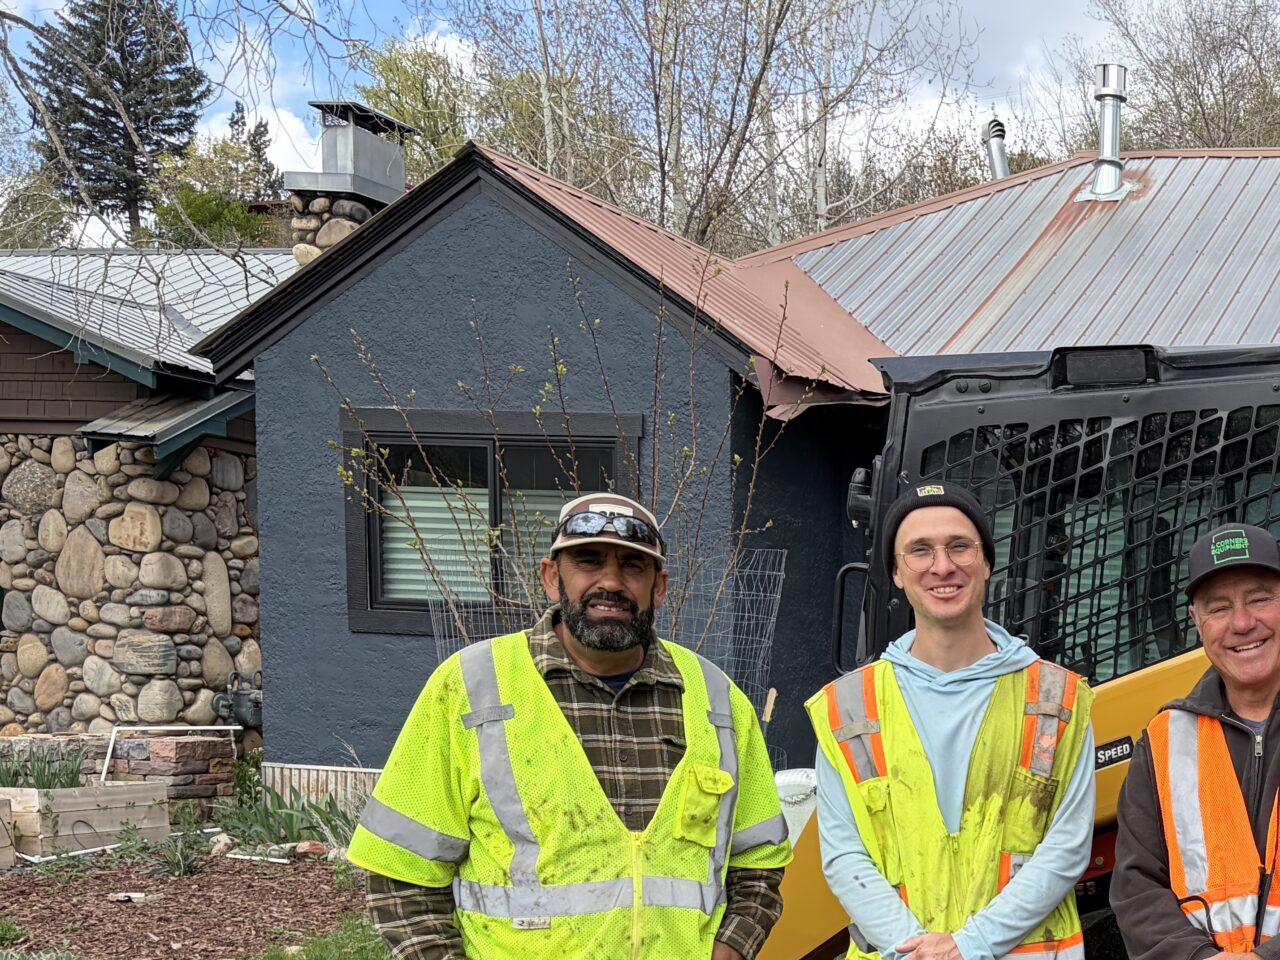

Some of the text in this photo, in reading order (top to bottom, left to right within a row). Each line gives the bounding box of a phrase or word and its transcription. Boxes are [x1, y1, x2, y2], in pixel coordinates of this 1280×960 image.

[1216, 537, 1249, 548] CORNERS
[1211, 543, 1248, 555] EQUIPMENT
[1097, 743, 1130, 763] SPEED
